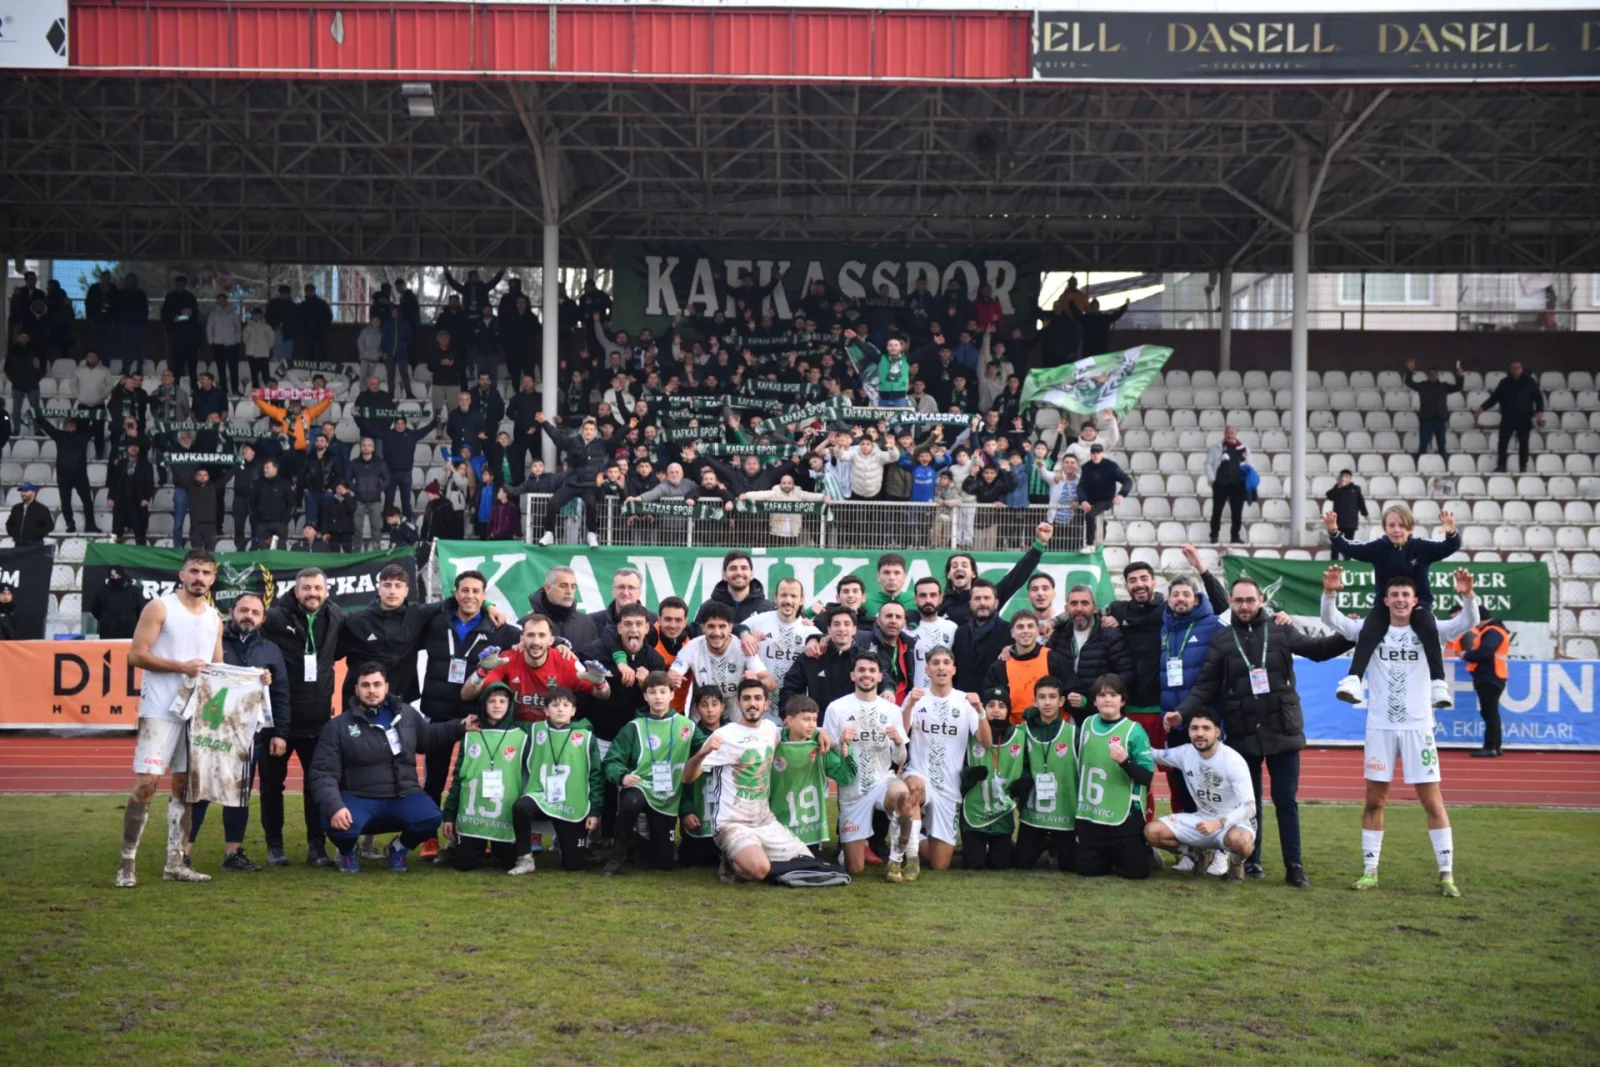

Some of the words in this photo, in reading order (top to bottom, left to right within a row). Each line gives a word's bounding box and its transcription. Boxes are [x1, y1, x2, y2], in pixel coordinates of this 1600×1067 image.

[1167, 23, 1336, 53] DASELL
[1378, 22, 1550, 53] DASELL
[1214, 61, 1290, 70] EXCLUSIVE
[1426, 62, 1503, 70] EXCLUSIVE
[757, 380, 782, 391] KAFKAS
[783, 382, 801, 392] SPOR
[780, 407, 807, 424] KAFKAS
[807, 401, 827, 416] SPOR
[843, 408, 872, 419] KAFKAS
[900, 411, 970, 424] KAFKASSPOR
[671, 426, 699, 438] KAFKAS
[699, 426, 719, 437] SPOR
[726, 445, 755, 455] KAFKAS
[756, 445, 777, 455] SPOR
[171, 452, 234, 463] KAFKASSPOR
[642, 502, 672, 514] KAFKAS
[673, 503, 694, 515] SPOR
[763, 502, 792, 512] KAFKAS
[794, 502, 815, 512] SPOR
[766, 645, 801, 661] Leta
[1379, 647, 1419, 661] Leta
[53, 704, 138, 715] HOM
[921, 719, 958, 736] Leta
[1453, 720, 1573, 739] EKİPANLARI
[1421, 748, 1438, 767] 99
[1078, 765, 1108, 806] 16
[464, 777, 505, 819] 13
[1195, 788, 1222, 803] eta
[785, 785, 821, 828] 19
